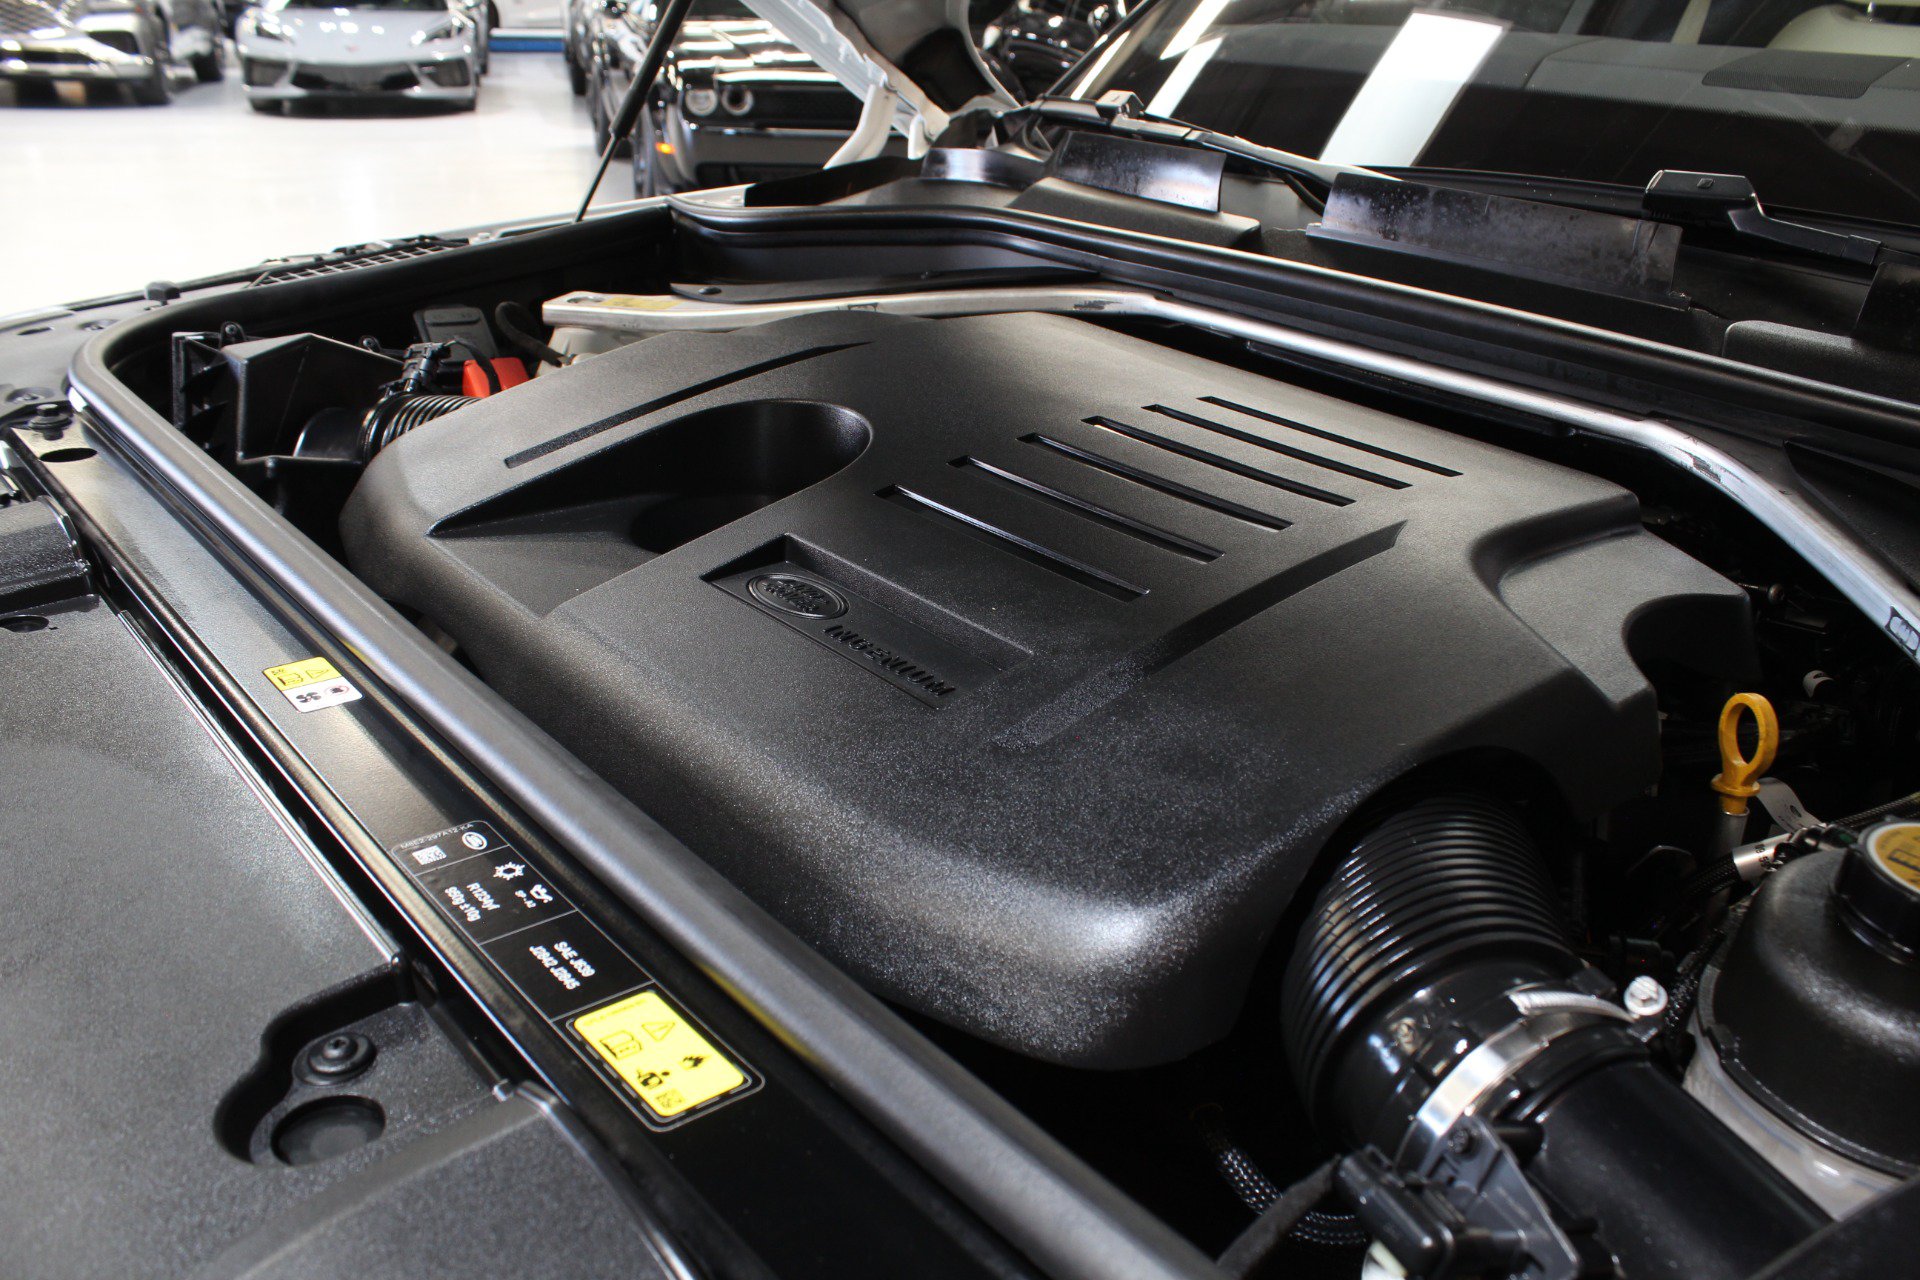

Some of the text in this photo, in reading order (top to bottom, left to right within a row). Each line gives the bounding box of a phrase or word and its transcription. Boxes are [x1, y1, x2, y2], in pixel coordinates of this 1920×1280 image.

[822, 625, 956, 697] INGENIUM
[466, 882, 501, 911] R1234yf
[553, 941, 578, 961] SAE
